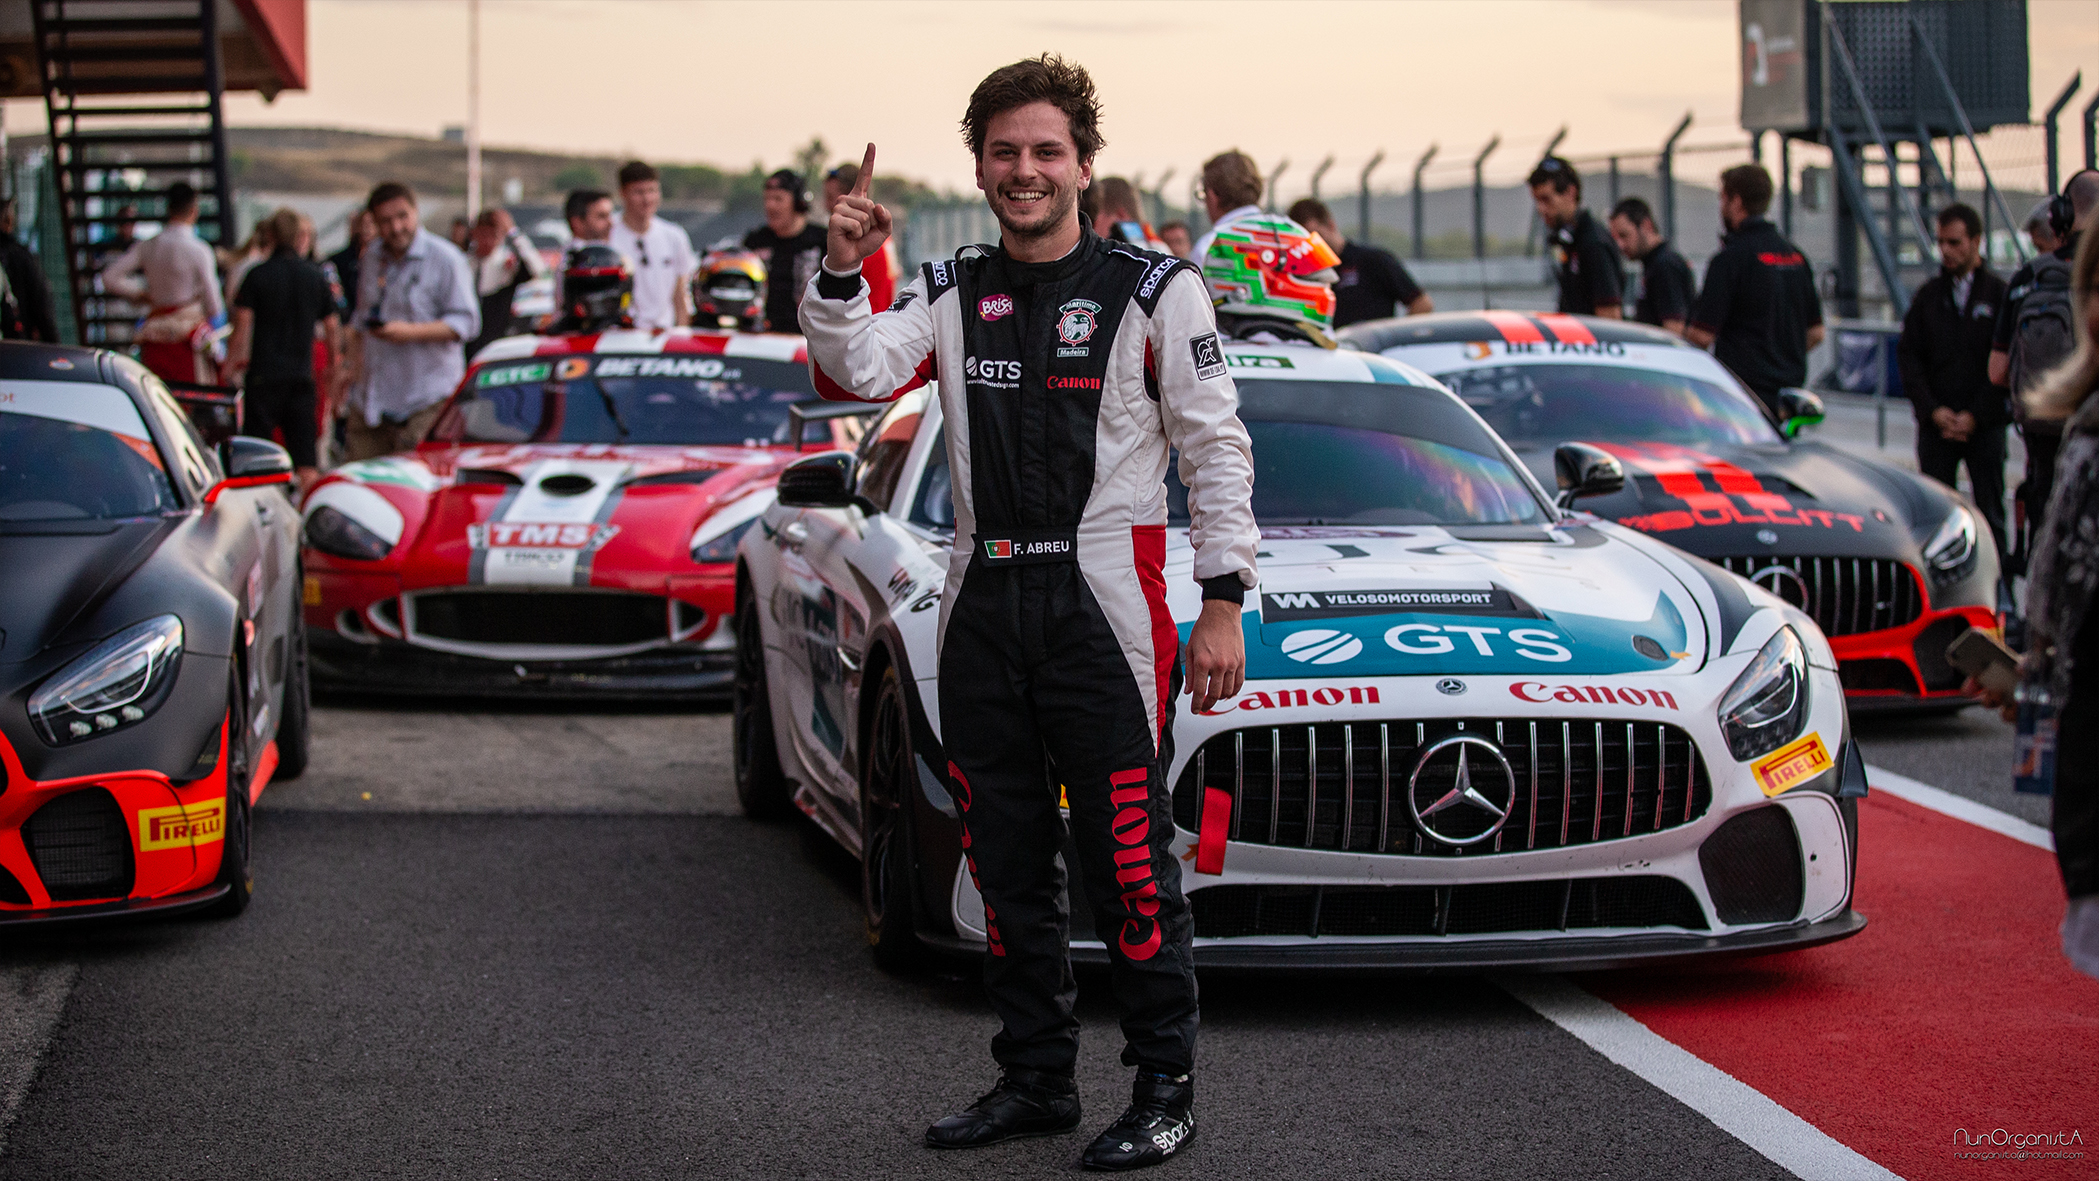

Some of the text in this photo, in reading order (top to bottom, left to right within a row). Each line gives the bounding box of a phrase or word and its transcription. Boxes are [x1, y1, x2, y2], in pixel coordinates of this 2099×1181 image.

[1140, 258, 1178, 298] sparco
[1060, 348, 1086, 356] Madeira
[595, 358, 724, 377] BETANO
[980, 360, 1021, 379] GTS
[1047, 376, 1100, 389] Canon
[491, 524, 589, 544] TMS
[1014, 541, 1069, 554] F. ABREU
[1325, 593, 1491, 605] VELOSOMOTORSPORT
[1384, 623, 1572, 663] GTS
[1509, 681, 1679, 711] Canon
[1759, 740, 1825, 790] PIRELLI
[150, 807, 220, 841] PIRELLI
[1110, 767, 1161, 960] Canon
